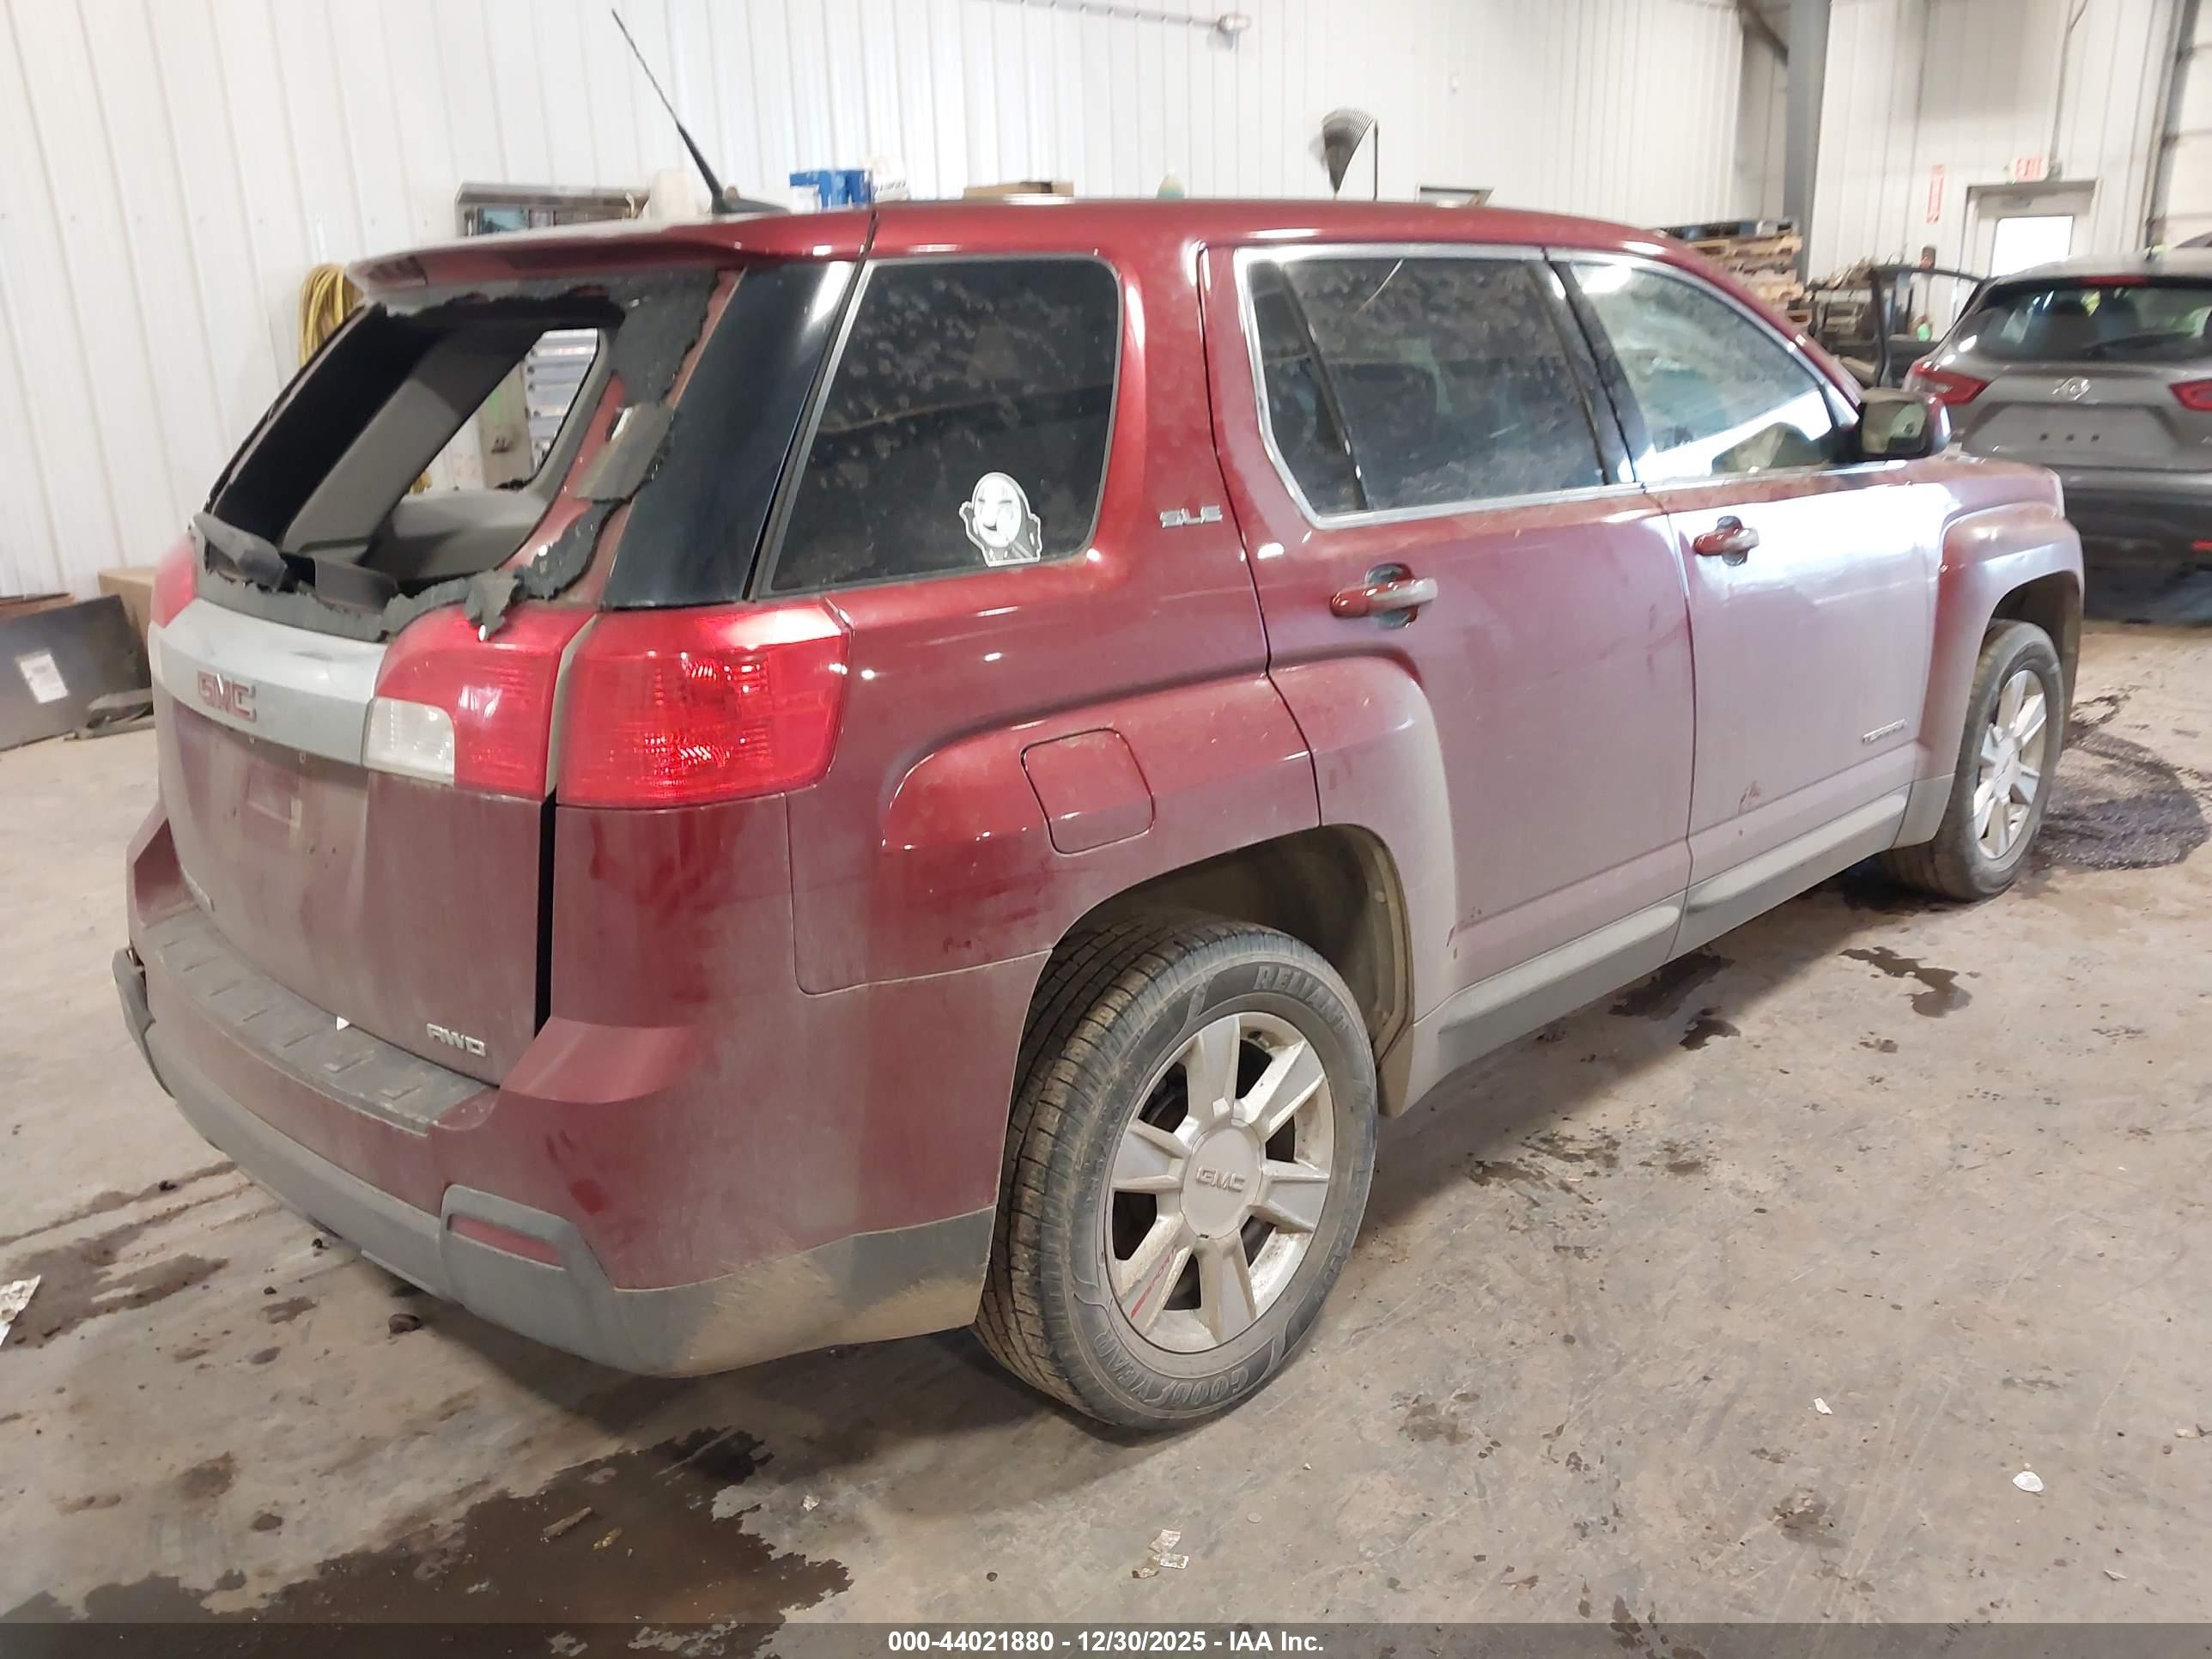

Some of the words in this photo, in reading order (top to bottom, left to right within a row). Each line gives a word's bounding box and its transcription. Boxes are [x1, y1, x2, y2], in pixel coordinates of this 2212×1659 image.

[197, 670, 258, 723] GMC
[426, 1022, 487, 1058] AWD
[1195, 1165, 1246, 1194] GMC
